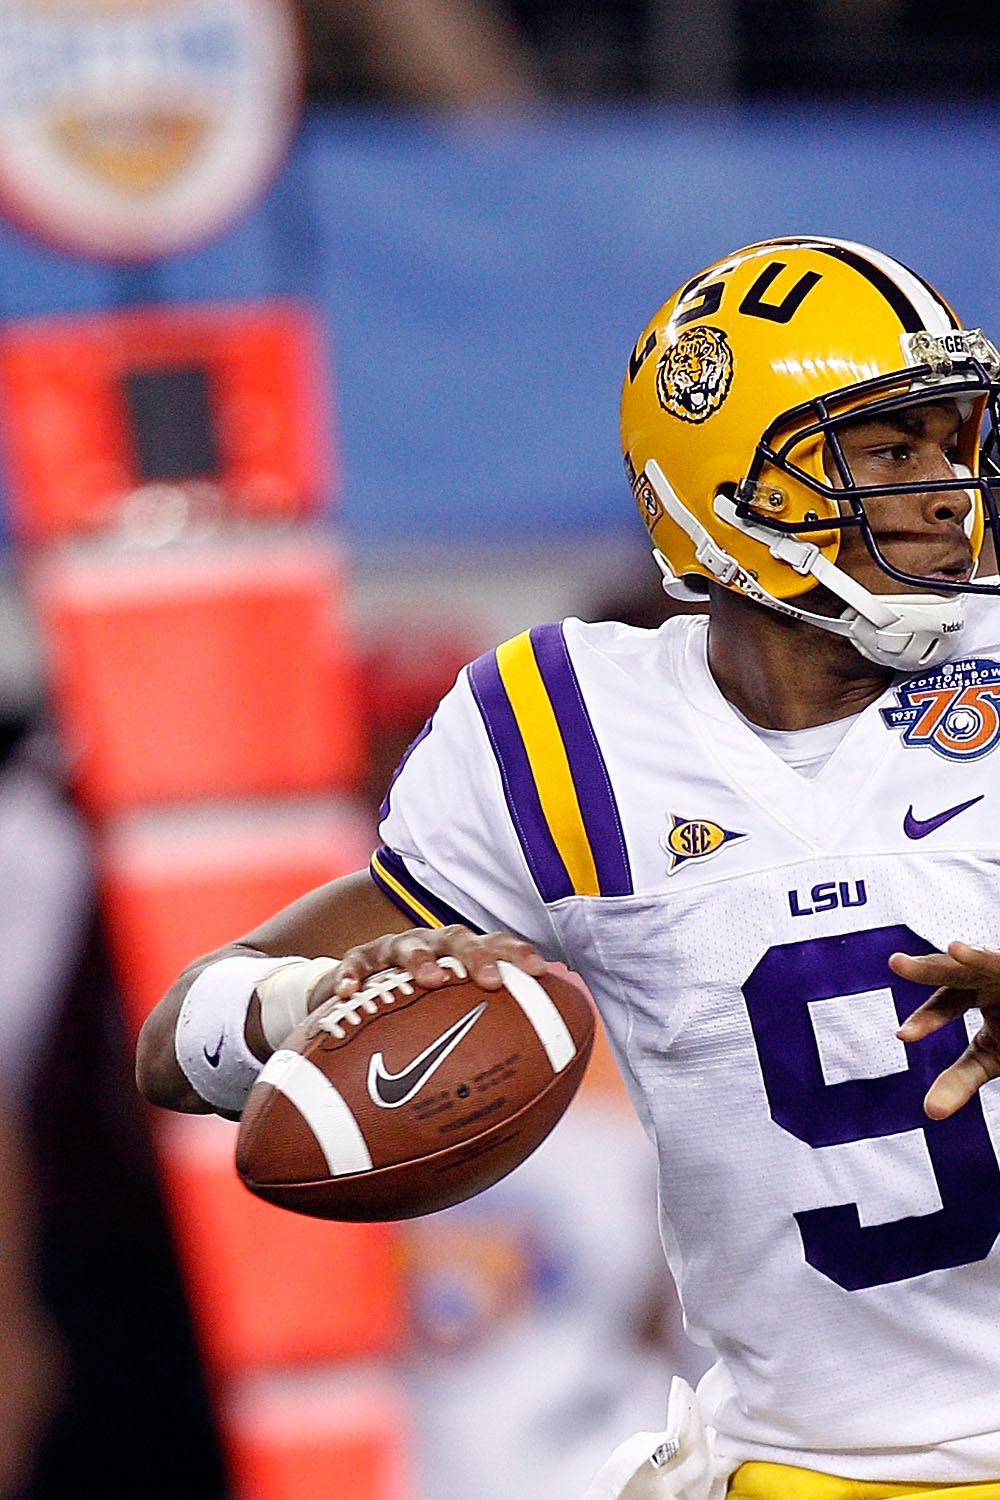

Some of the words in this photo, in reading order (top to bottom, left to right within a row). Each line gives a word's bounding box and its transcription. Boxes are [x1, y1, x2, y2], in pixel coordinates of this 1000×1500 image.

[909, 672, 963, 689] COTTON
[934, 677, 983, 689] CLASSIC
[890, 710, 917, 722] 1937
[679, 823, 712, 855] SEC
[787, 879, 868, 917] LSU
